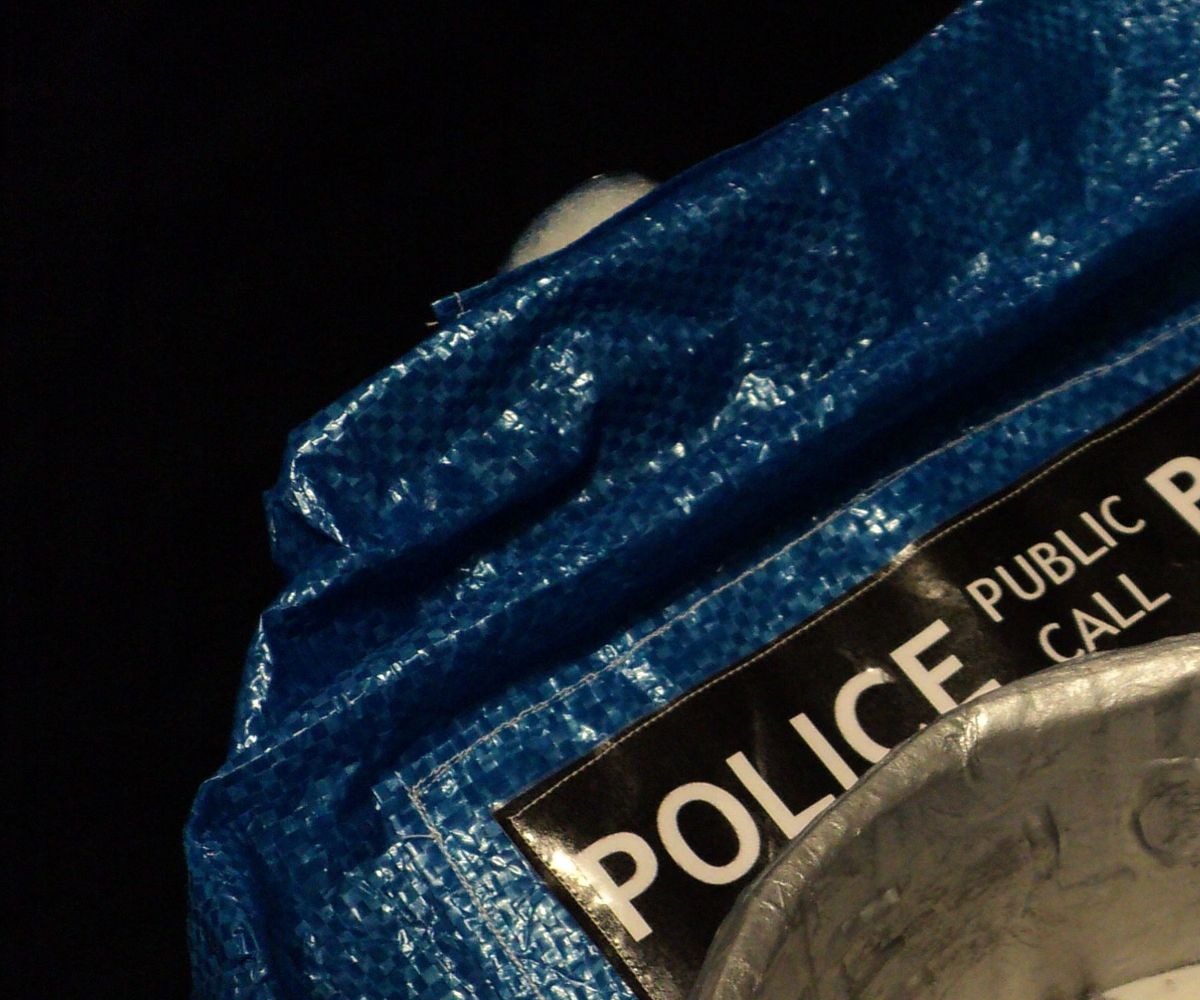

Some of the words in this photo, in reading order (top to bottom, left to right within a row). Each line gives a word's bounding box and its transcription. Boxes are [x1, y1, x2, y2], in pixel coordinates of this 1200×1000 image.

[965, 494, 1147, 624] PUBLIC
[1038, 572, 1172, 663] CALL
[576, 618, 1003, 943] POLICE
